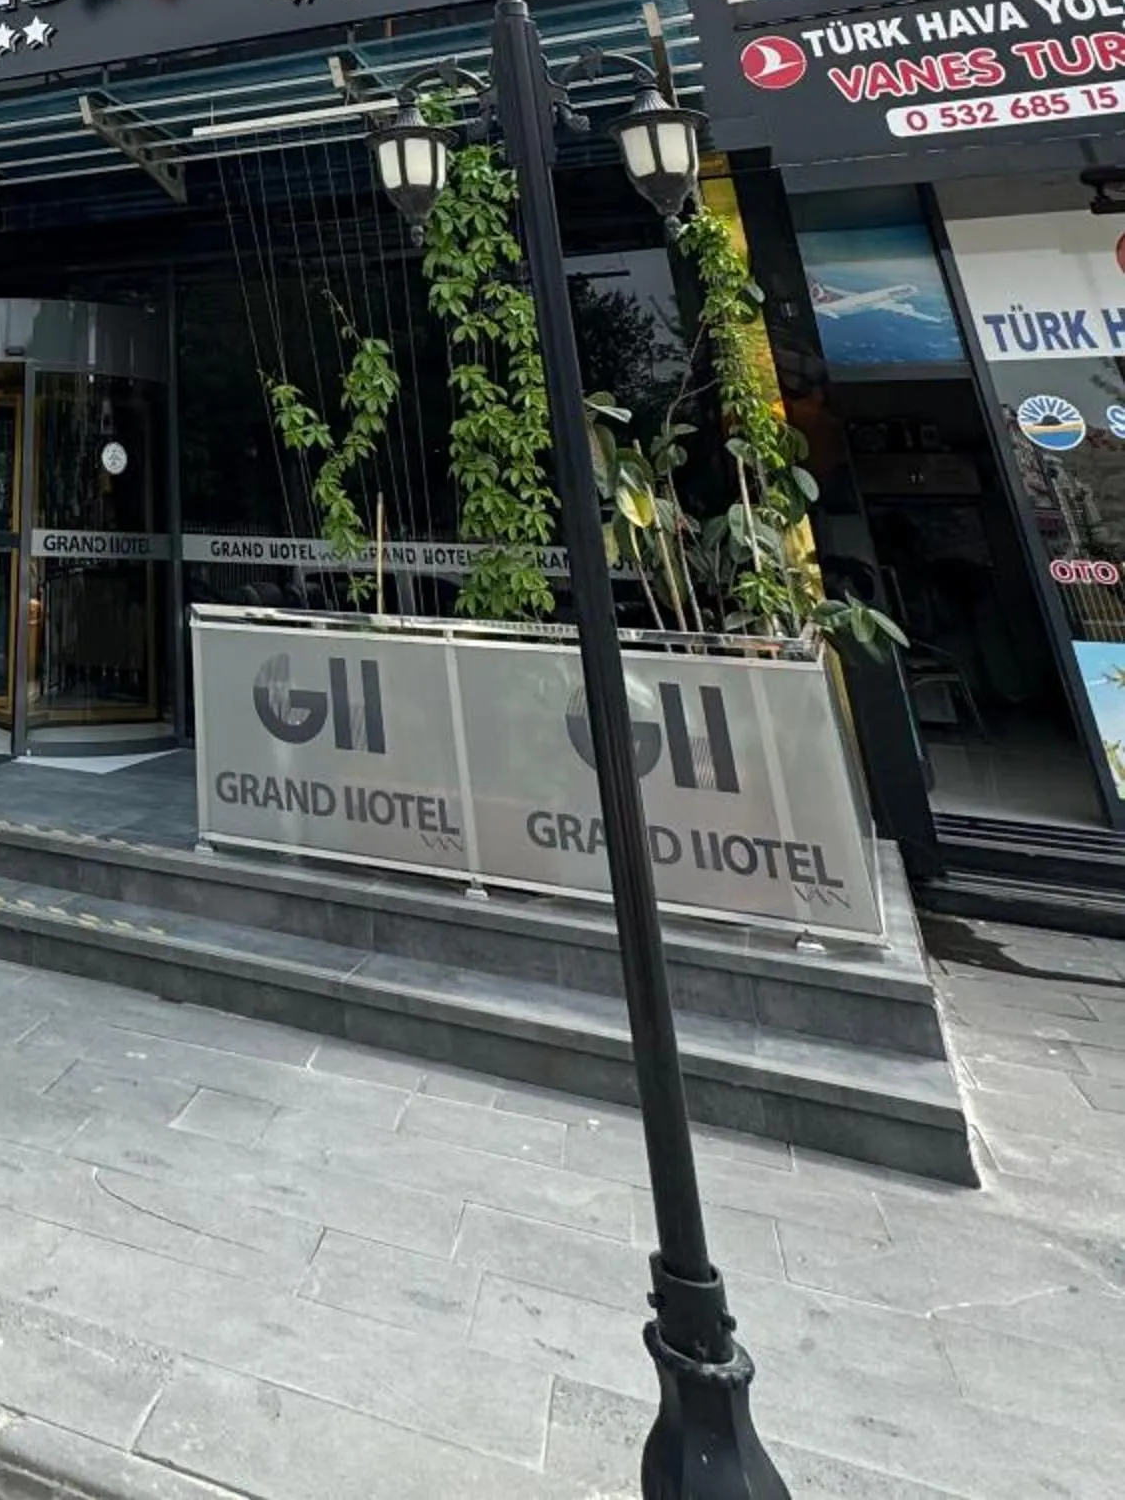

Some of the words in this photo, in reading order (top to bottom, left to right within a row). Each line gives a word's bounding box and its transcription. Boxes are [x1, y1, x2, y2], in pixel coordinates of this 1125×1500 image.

[801, 17, 911, 59] TÜRK
[916, 1, 1029, 42] HAVA
[828, 47, 1005, 102] VANES
[940, 102, 998, 129] 532
[1010, 92, 1070, 119] 685
[1079, 86, 1119, 111] 15
[982, 303, 1100, 353] TÜRK
[43, 533, 107, 553] GRAND
[210, 540, 264, 558] GRAND
[1050, 559, 1119, 585] OTO
[215, 770, 336, 817] GRAND
[344, 784, 461, 837] HOTEL
[526, 810, 683, 865] GRAD
[692, 832, 844, 889] HOTEL
